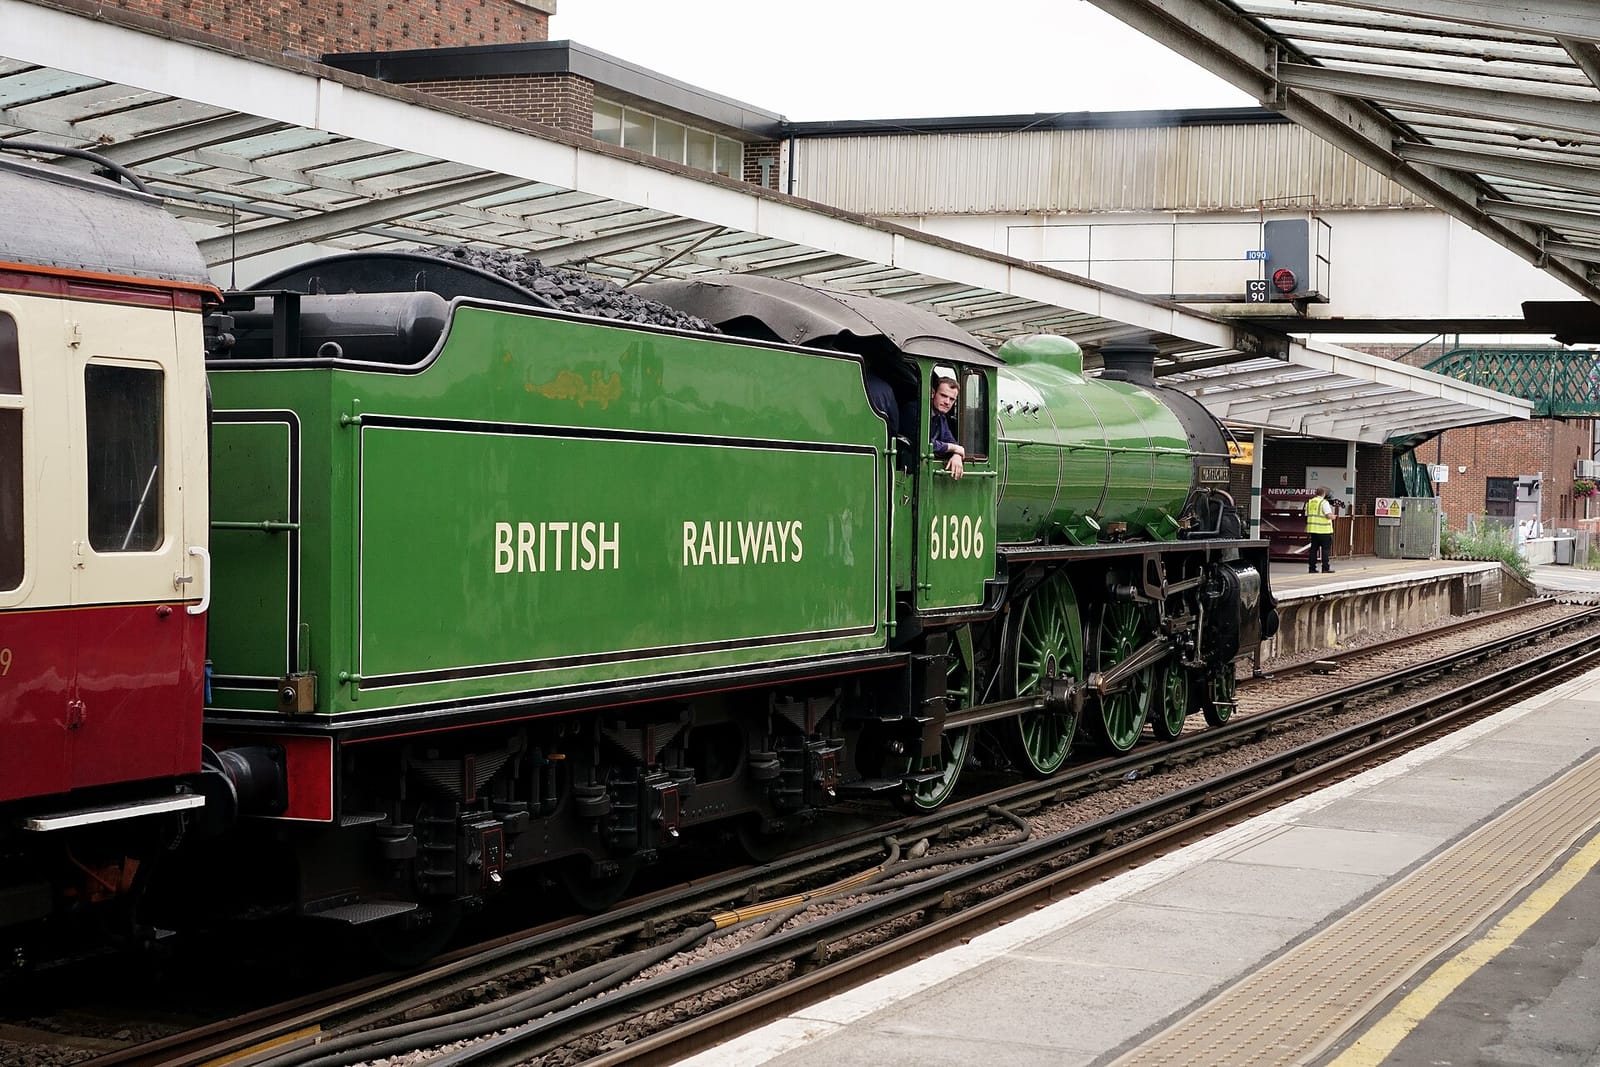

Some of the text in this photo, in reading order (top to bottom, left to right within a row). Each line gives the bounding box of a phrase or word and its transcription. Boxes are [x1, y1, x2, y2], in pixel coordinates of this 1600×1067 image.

[1249, 251, 1266, 259] 1090
[1250, 281, 1266, 291] CC
[1252, 292, 1265, 302] 90
[495, 520, 803, 573] BRITISH RAILWAYS
[931, 514, 984, 560] 61306
[0, 648, 12, 676] 9
